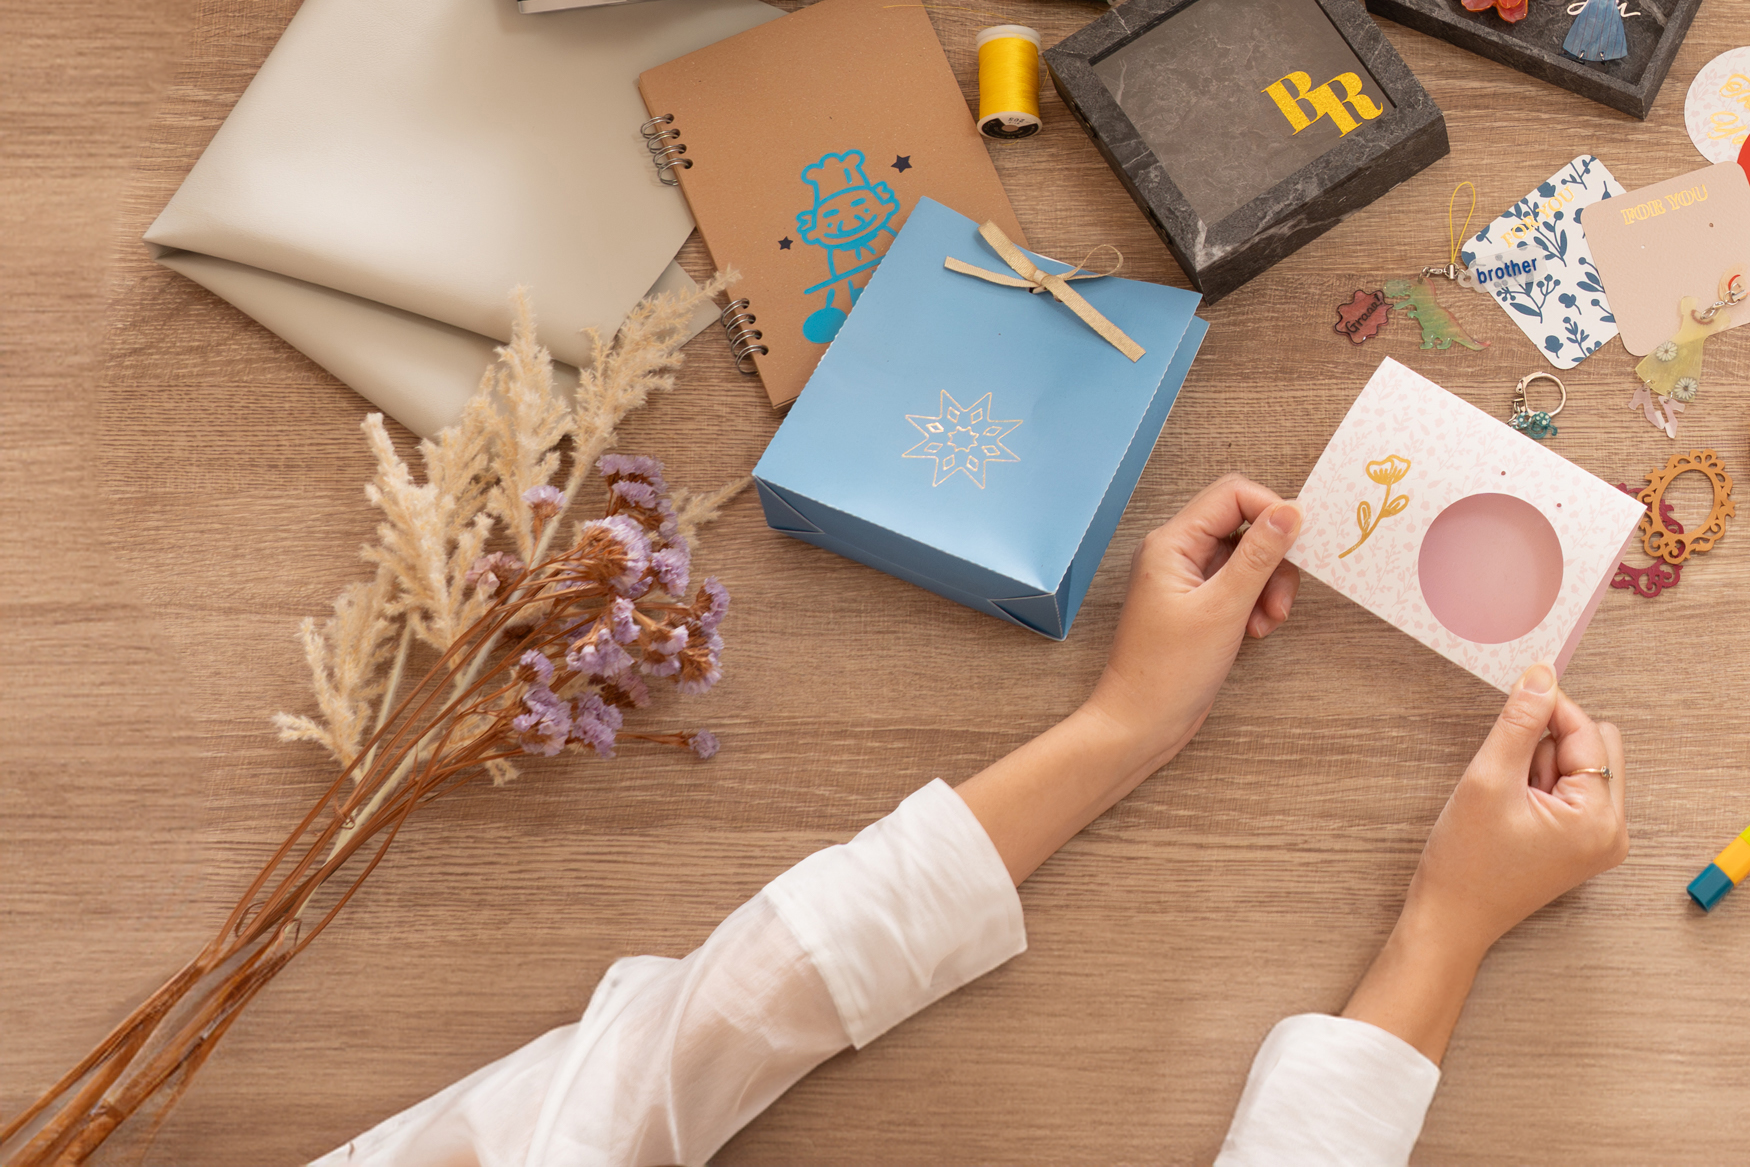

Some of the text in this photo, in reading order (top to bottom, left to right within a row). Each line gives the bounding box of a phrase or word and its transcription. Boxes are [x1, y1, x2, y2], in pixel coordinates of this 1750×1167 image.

[1261, 71, 1383, 138] BR
[1500, 185, 1575, 248] FOR YOU
[1620, 184, 1709, 225] FOR YOU
[1476, 257, 1538, 285] brother
